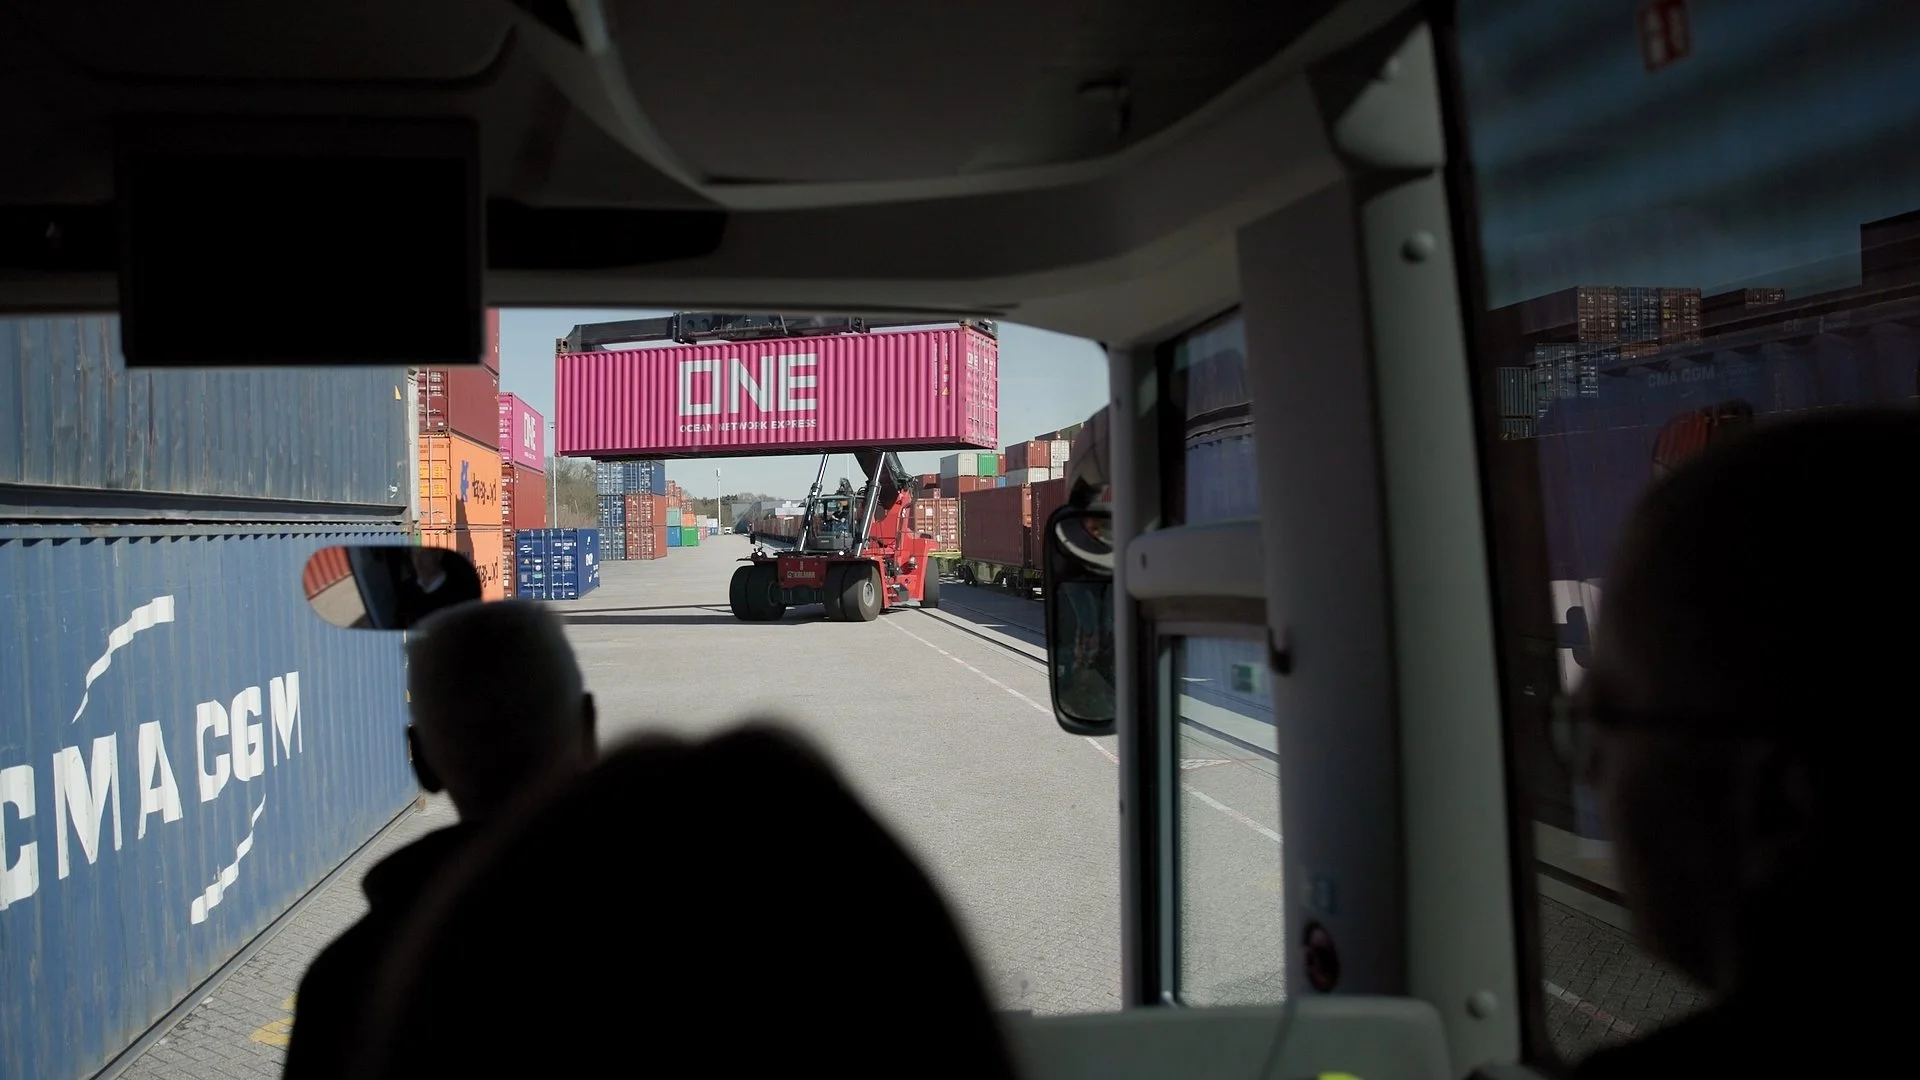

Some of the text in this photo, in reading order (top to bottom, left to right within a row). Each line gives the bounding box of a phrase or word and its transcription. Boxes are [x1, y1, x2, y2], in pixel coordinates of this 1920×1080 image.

[679, 353, 817, 416] ONE
[524, 411, 536, 451] ONE
[679, 418, 817, 433] OCEAN NETWORK EXPRESS
[0, 671, 302, 909] CMA CGM
